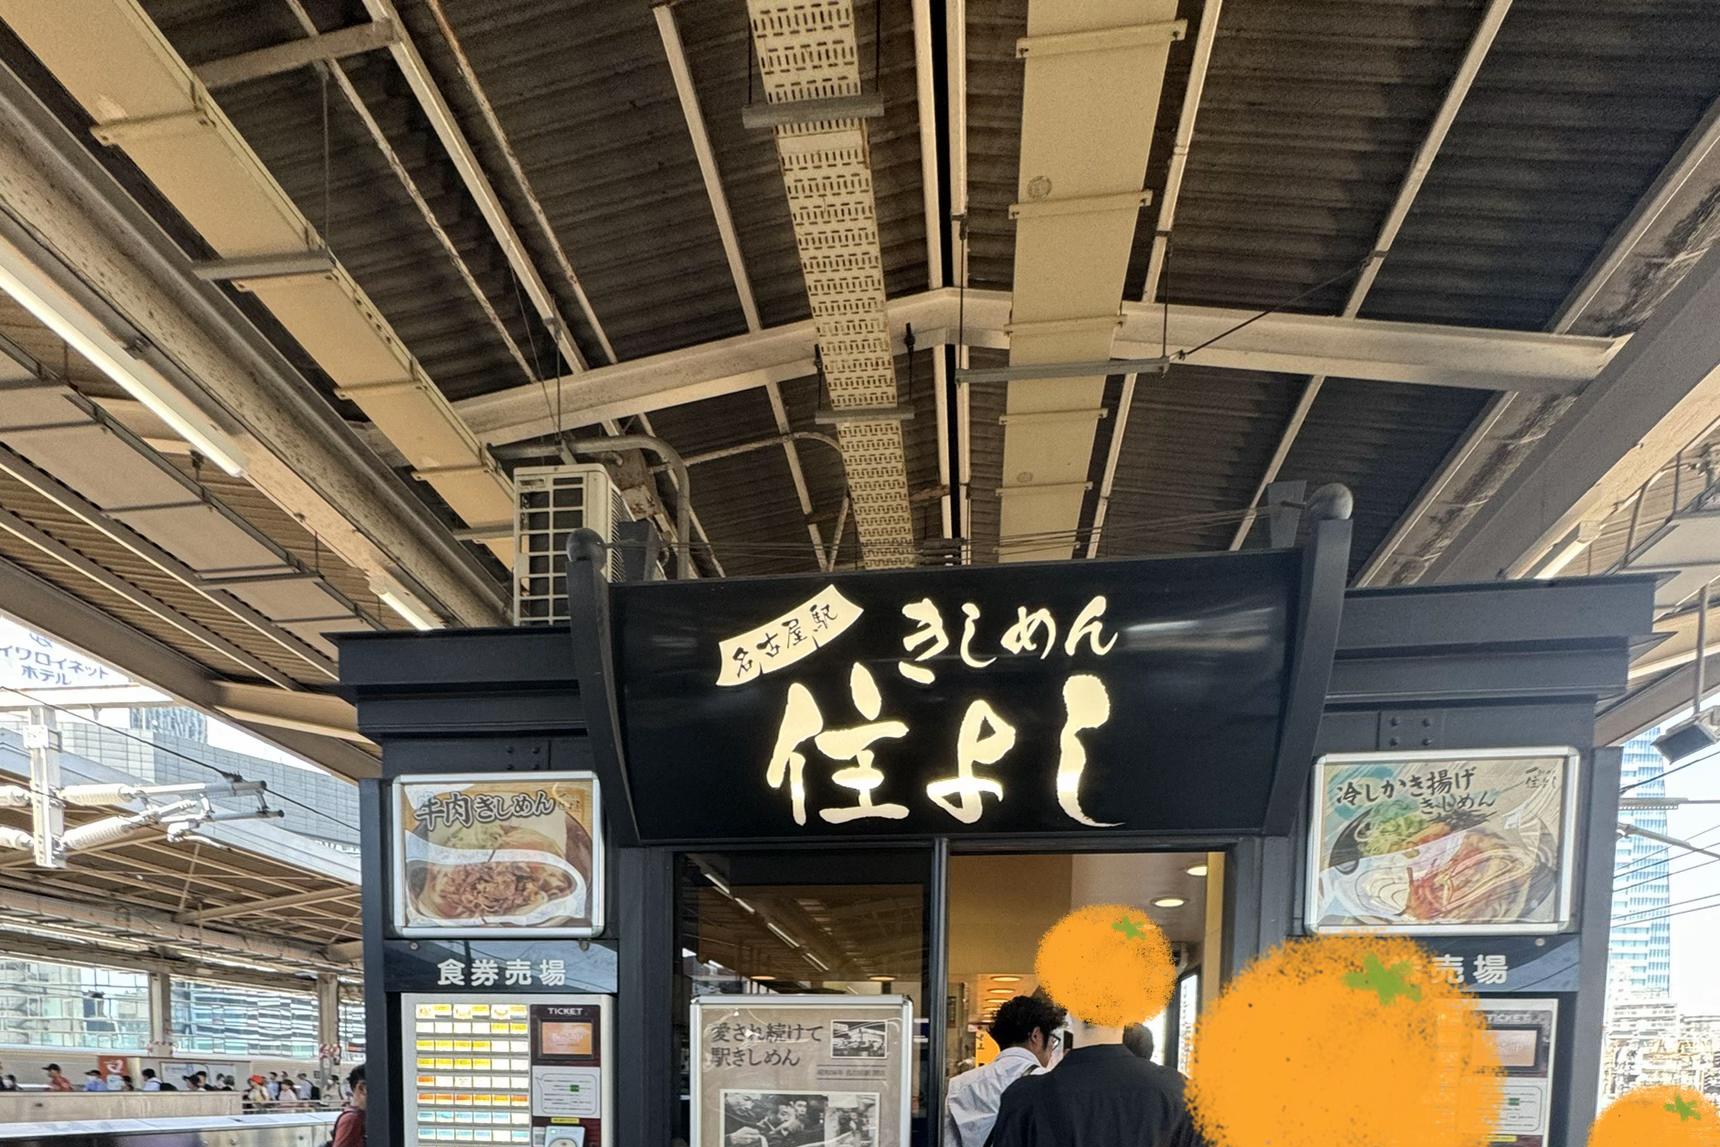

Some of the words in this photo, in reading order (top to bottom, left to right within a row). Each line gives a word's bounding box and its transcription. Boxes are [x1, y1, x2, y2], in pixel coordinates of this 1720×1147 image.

[732, 603, 838, 679] 名古屋駅
[899, 595, 1118, 684] きしめん
[21, 665, 71, 686] ホテル
[766, 662, 1126, 829] 住よし
[1336, 765, 1477, 806] 冷しかき揚げ
[415, 791, 556, 831] 牛肉きしめん
[1420, 791, 1496, 815] きしめん
[437, 958, 566, 986] 食券売場
[548, 1007, 583, 1016] TICKET
[711, 1022, 824, 1043] 愛され続けて
[711, 1048, 801, 1067] 駅きしめん
